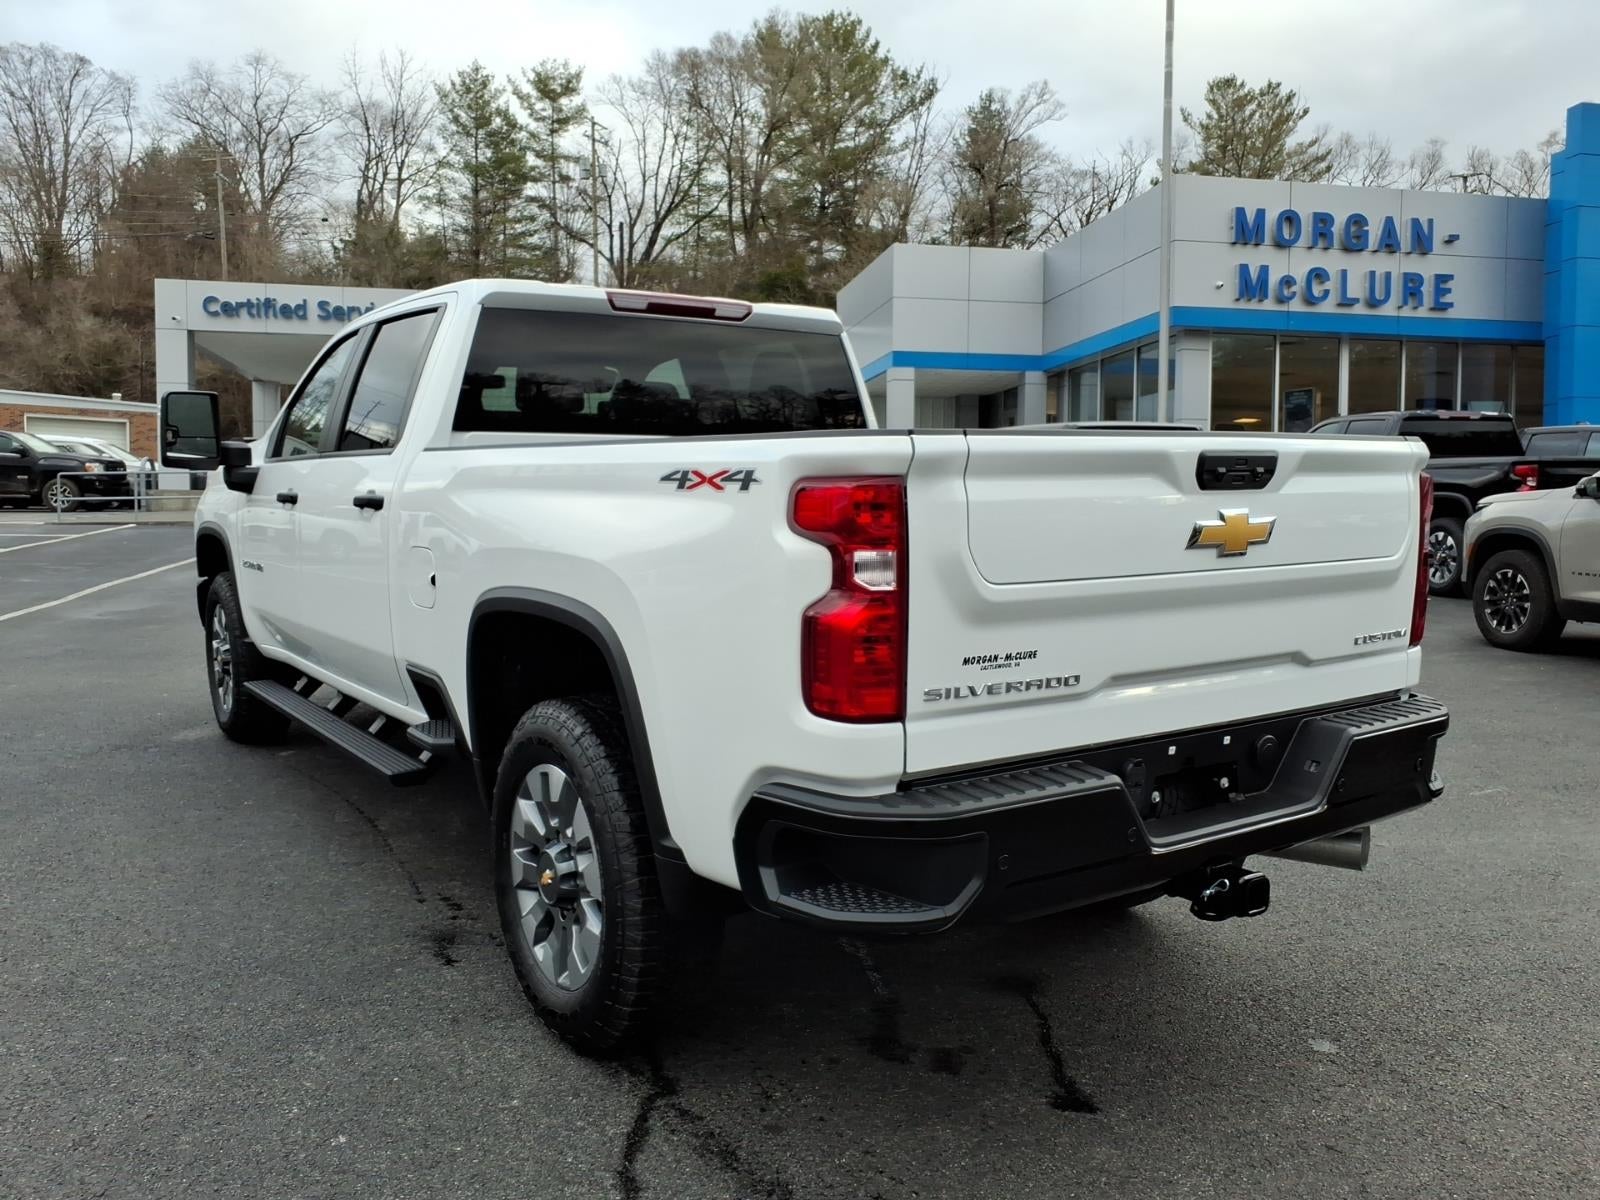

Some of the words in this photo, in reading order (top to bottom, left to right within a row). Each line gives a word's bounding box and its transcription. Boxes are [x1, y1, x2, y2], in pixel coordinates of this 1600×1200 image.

[1233, 207, 1460, 254] MORGAN-
[1236, 263, 1455, 311] McCLURE
[202, 295, 308, 321] Certified
[923, 674, 1081, 702] SILVERADO
